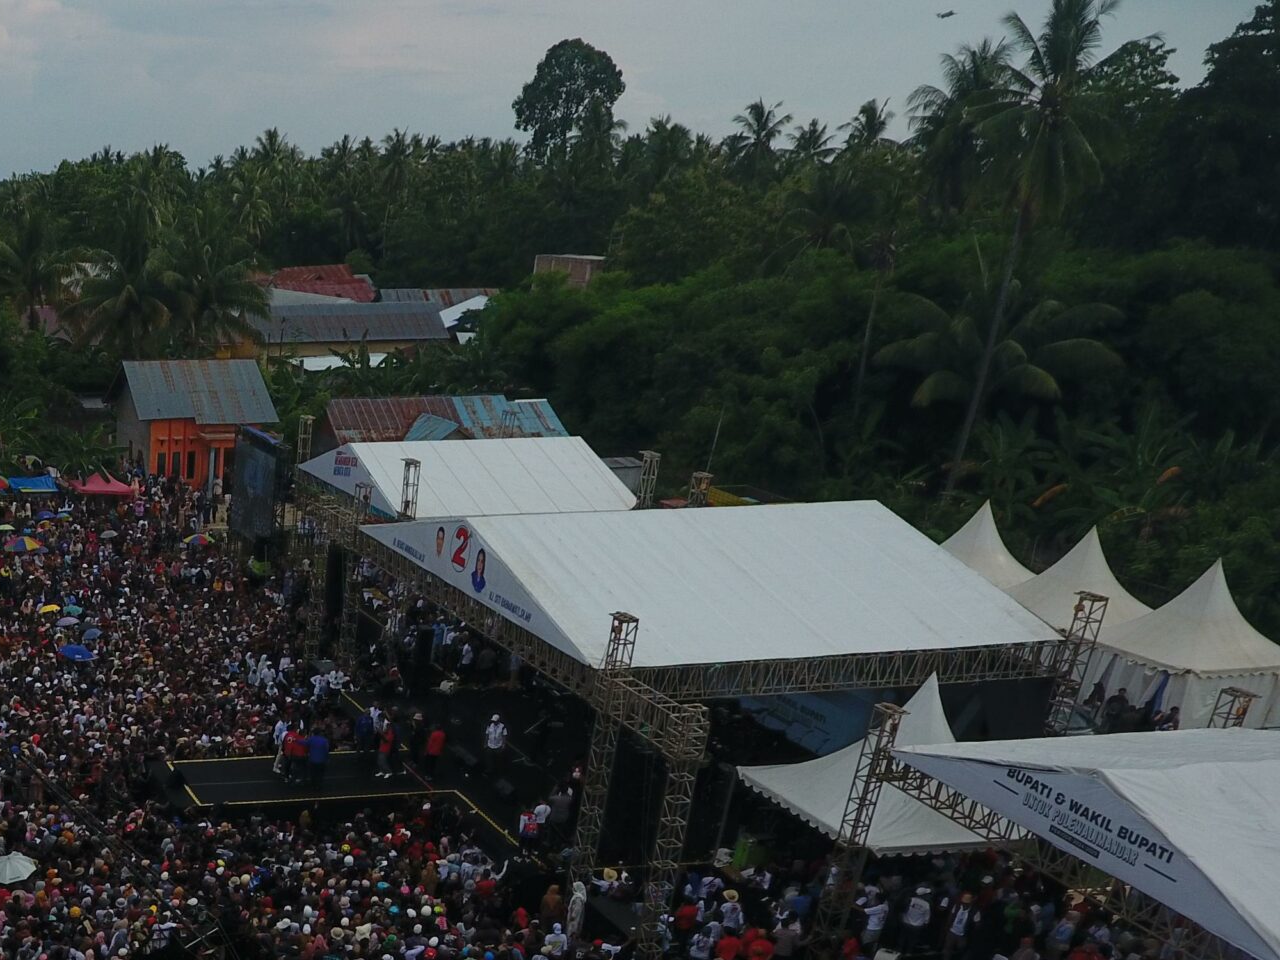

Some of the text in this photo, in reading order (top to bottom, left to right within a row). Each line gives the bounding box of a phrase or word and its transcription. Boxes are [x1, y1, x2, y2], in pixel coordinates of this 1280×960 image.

[451, 527, 469, 568] 2
[1007, 769, 1053, 799] BUPATI
[1055, 792, 1066, 805] &
[1069, 799, 1113, 833] WAKIL
[1117, 825, 1175, 863] BUPATI
[1022, 792, 1053, 818] UNTUK
